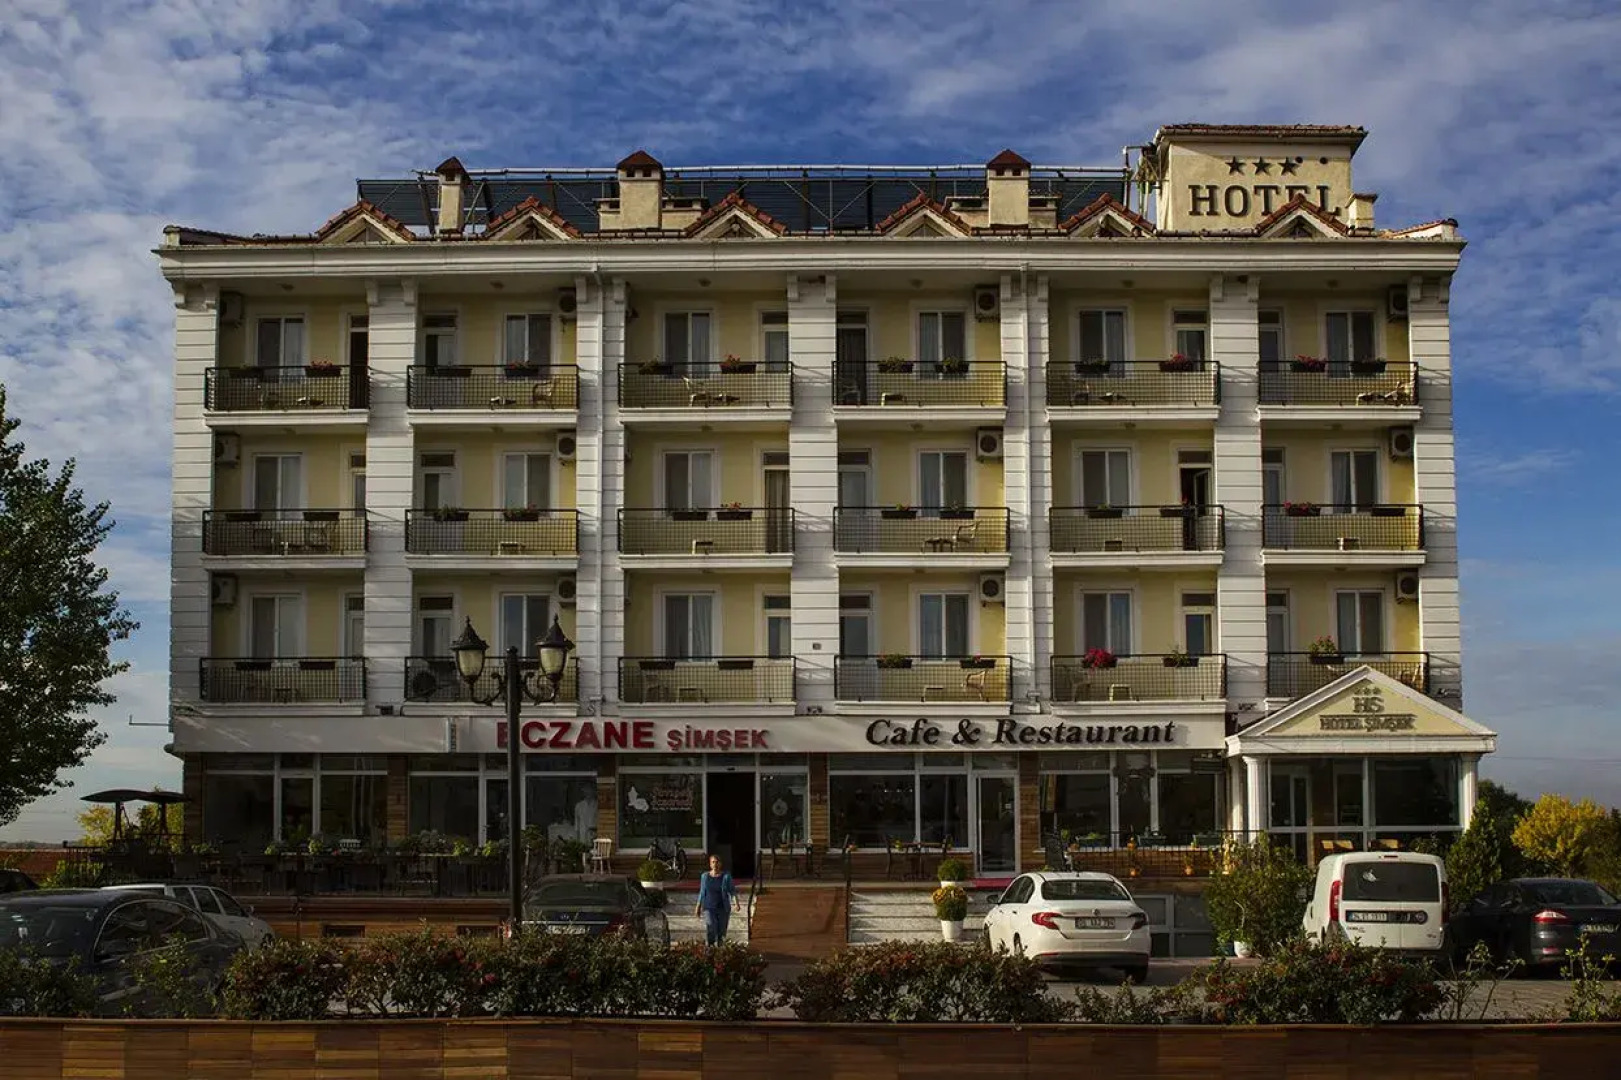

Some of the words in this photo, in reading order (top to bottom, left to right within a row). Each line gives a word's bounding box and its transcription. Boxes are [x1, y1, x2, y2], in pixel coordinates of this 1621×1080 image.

[1353, 697, 1384, 713] HS
[866, 718, 939, 746] Cafe
[952, 718, 981, 746] &
[993, 718, 1176, 745] Restaurant
[1320, 718, 1362, 730] HOTEL
[667, 725, 770, 751] ŞİMŞEK
